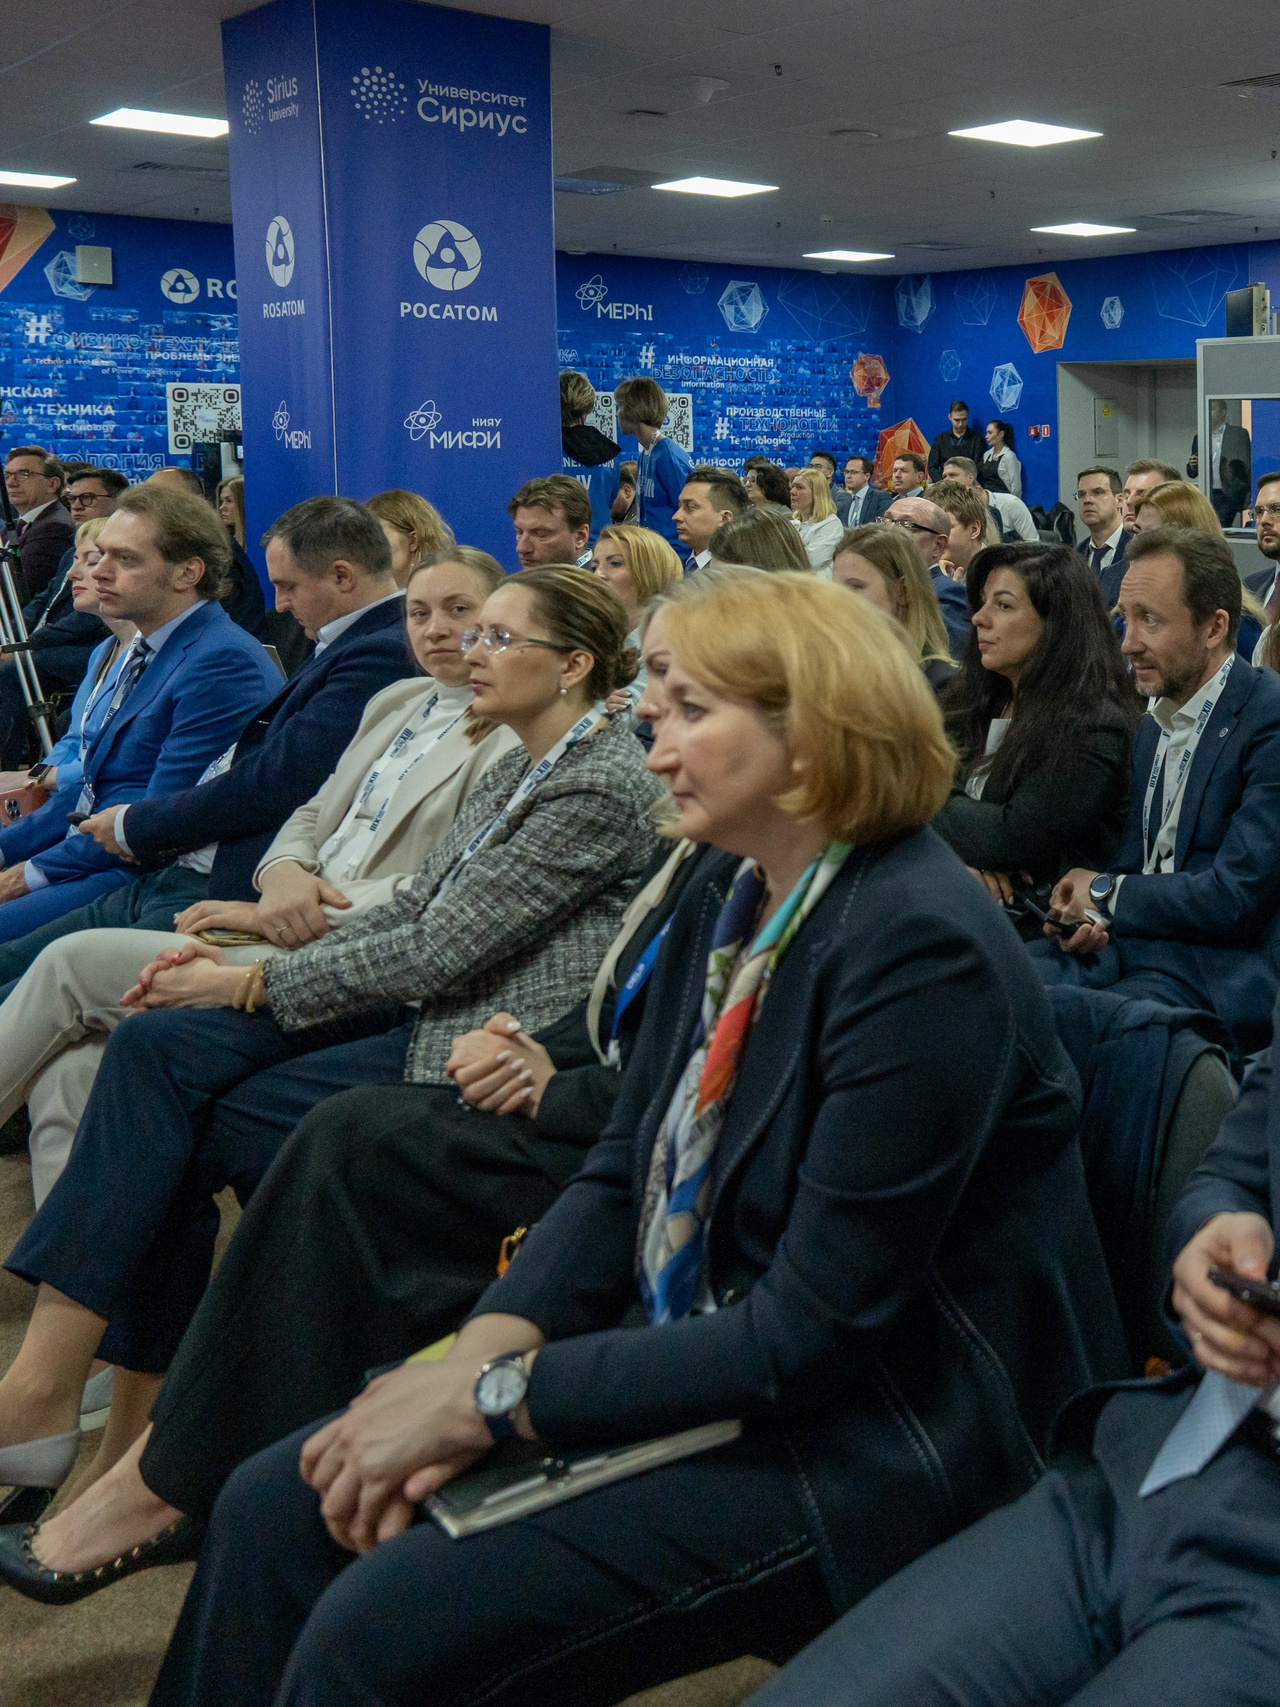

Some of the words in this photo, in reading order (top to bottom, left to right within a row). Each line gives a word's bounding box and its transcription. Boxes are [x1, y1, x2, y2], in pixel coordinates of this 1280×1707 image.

[266, 75, 298, 103] Sirius
[417, 78, 527, 108] Университет
[268, 103, 299, 122] University
[416, 96, 528, 137] Сириус
[263, 299, 306, 319] ROSATOM
[400, 301, 498, 322] РОСАТОМ
[597, 302, 653, 321] MEPhI
[144, 352, 211, 361] ПРОБЛЕМЫ
[667, 355, 774, 368] ИНФОРМАЦИОННАЯ
[651, 364, 776, 382] БЕЗОПАСНОСТЬ
[681, 380, 725, 389] Information
[36, 403, 116, 416] ТЕХНИКА
[726, 407, 827, 418] ПРОИЗВОДСТВЕННЫЕ
[56, 423, 116, 433] Technology
[472, 417, 502, 427] НИЯУ
[739, 416, 838, 432] ТЕХНОЛОГИИ
[284, 430, 312, 449] MEPhI
[429, 430, 501, 449] МИФИ
[1201, 699, 1214, 715] XIII
[399, 727, 414, 742] XIII
[1182, 749, 1192, 765] XIII
[537, 759, 553, 774] XIII
[1149, 774, 1158, 788] XIII
[369, 818, 381, 832] XIII
